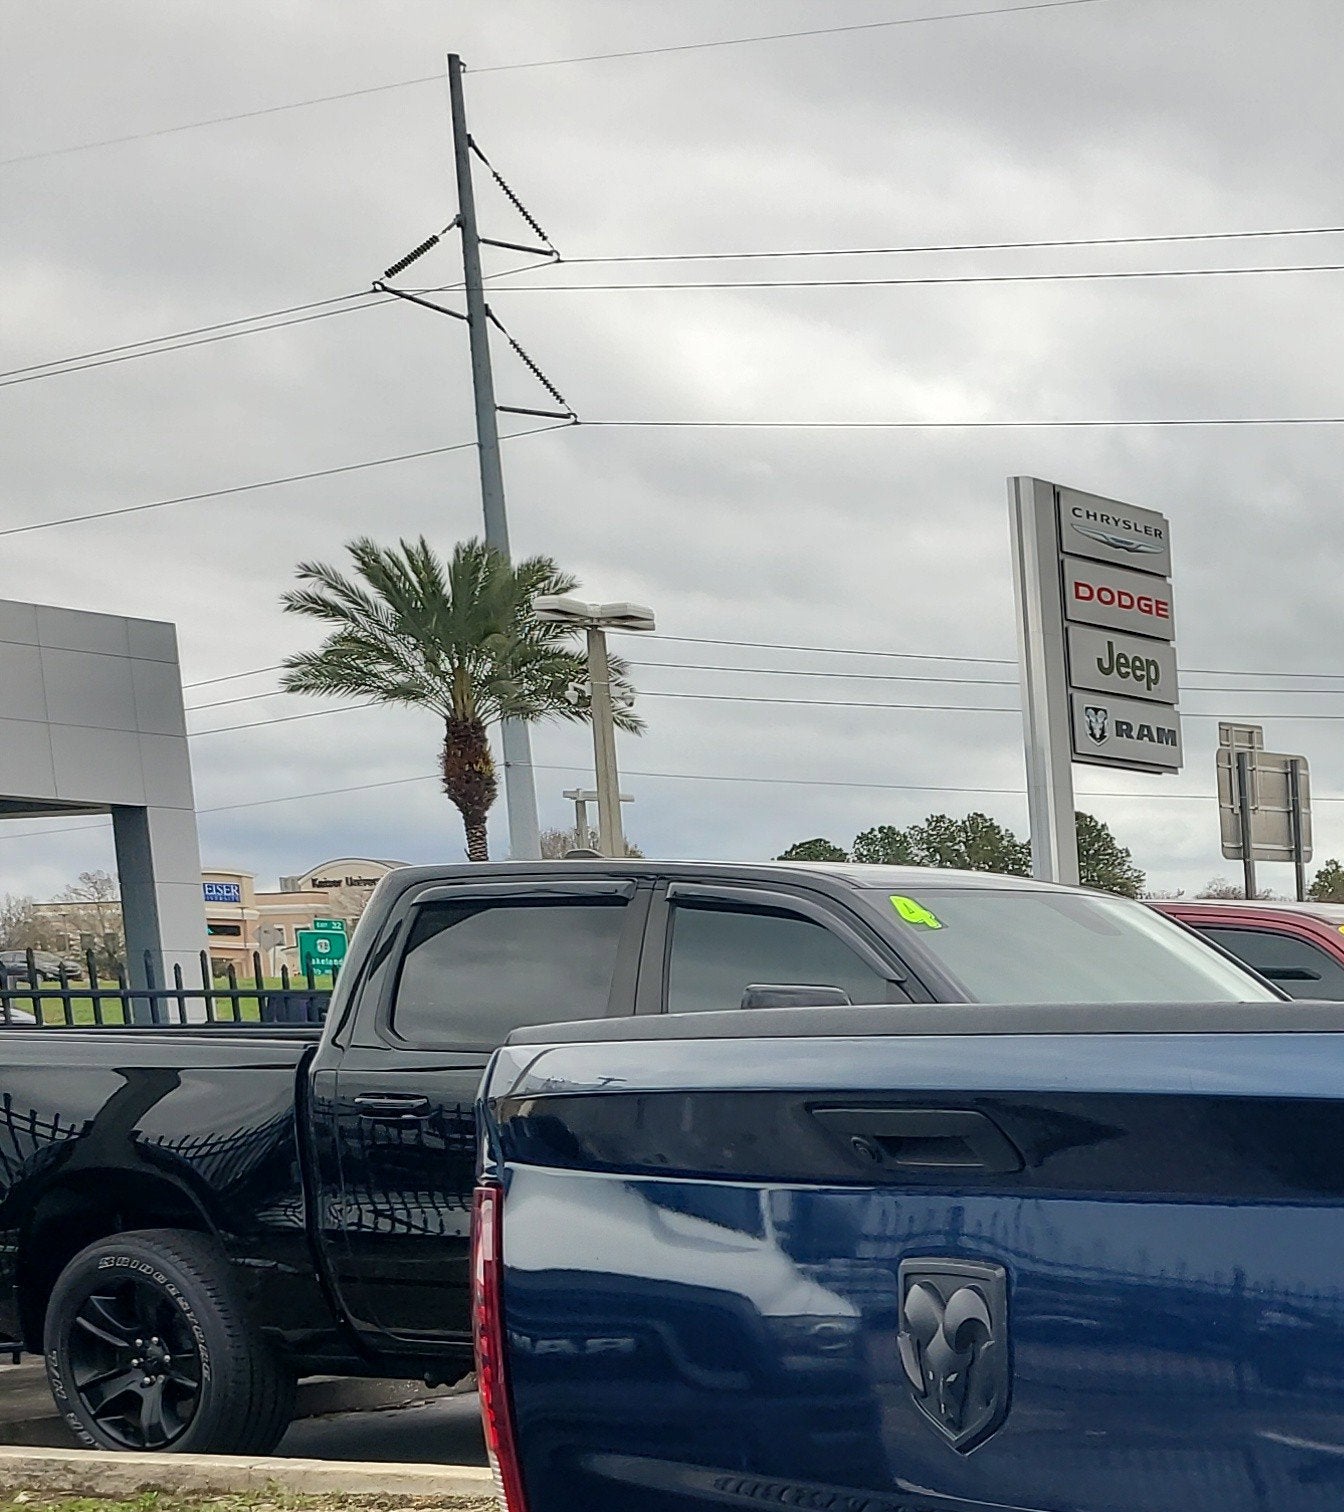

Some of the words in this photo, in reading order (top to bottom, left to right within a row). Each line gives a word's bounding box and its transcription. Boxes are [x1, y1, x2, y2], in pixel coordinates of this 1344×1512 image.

[1071, 506, 1163, 540] CHRYSLER
[1073, 581, 1170, 619] DODGE
[1096, 640, 1160, 691] Jeep
[1115, 719, 1177, 747] RAM
[889, 895, 943, 929] 4
